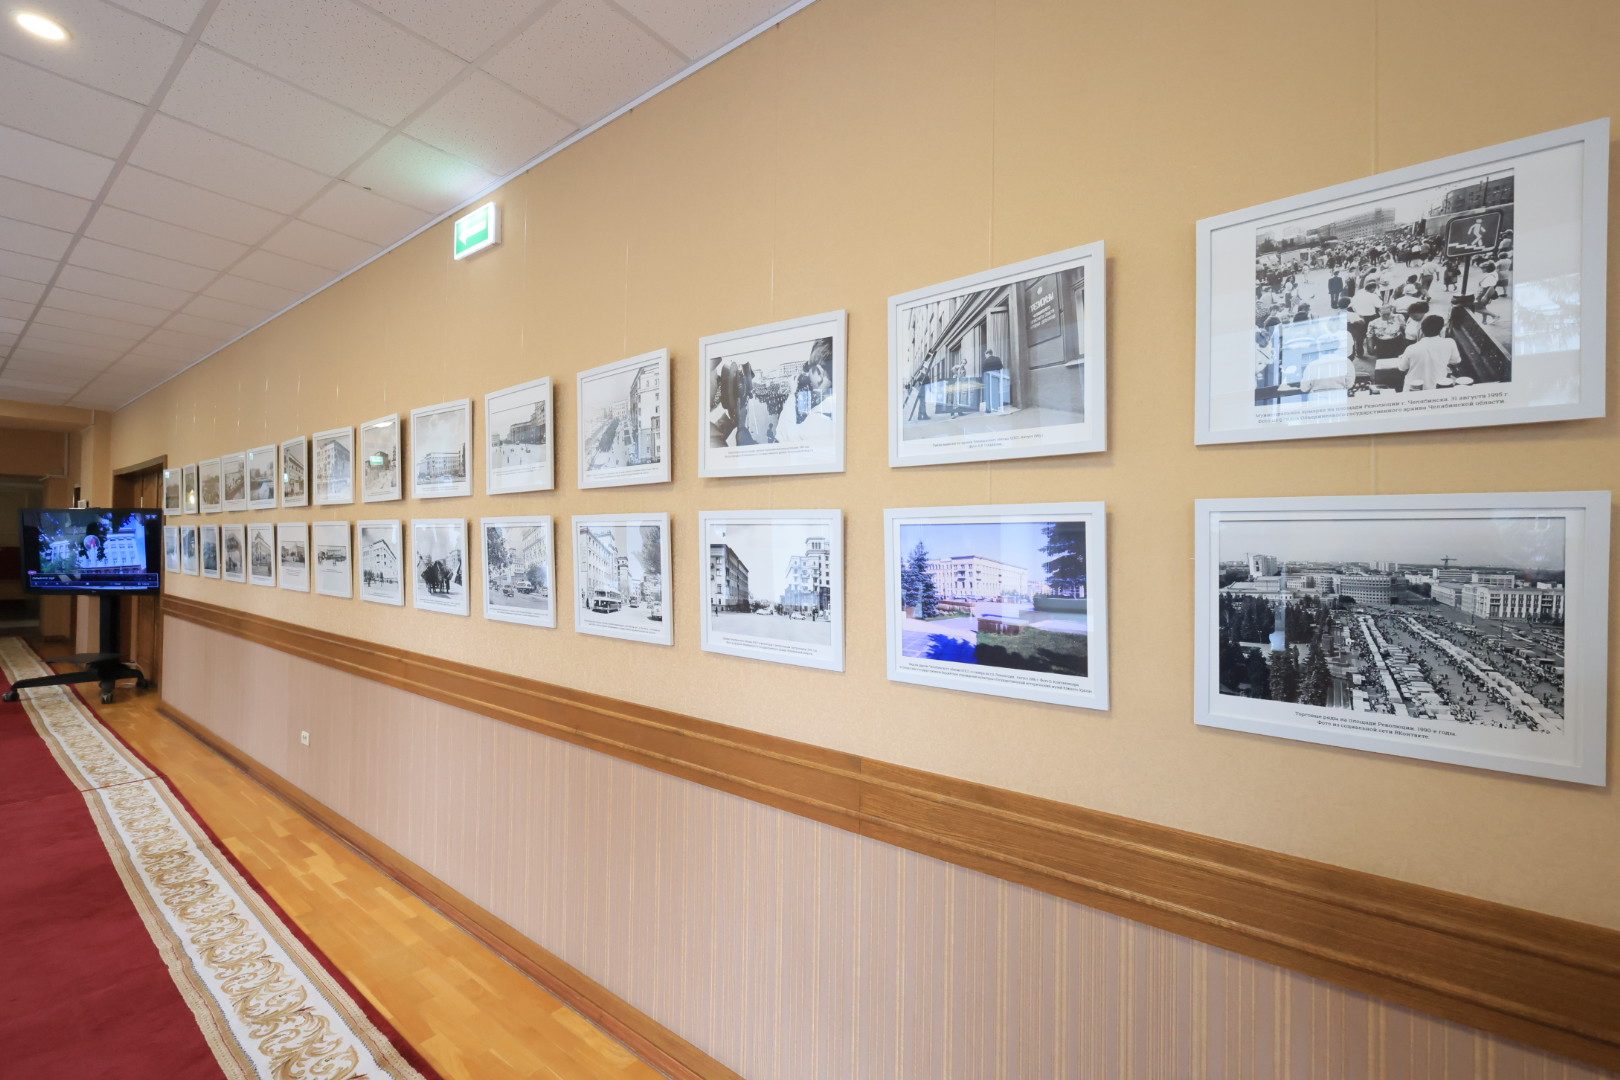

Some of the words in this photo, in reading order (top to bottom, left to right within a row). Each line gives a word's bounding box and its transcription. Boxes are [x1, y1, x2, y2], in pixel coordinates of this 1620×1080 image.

[1459, 394, 1486, 402] августа
[1428, 401, 1474, 410] Челябинской
[1295, 711, 1322, 719] Торговые
[1349, 718, 1376, 726] площади
[1341, 724, 1377, 732] социальной
